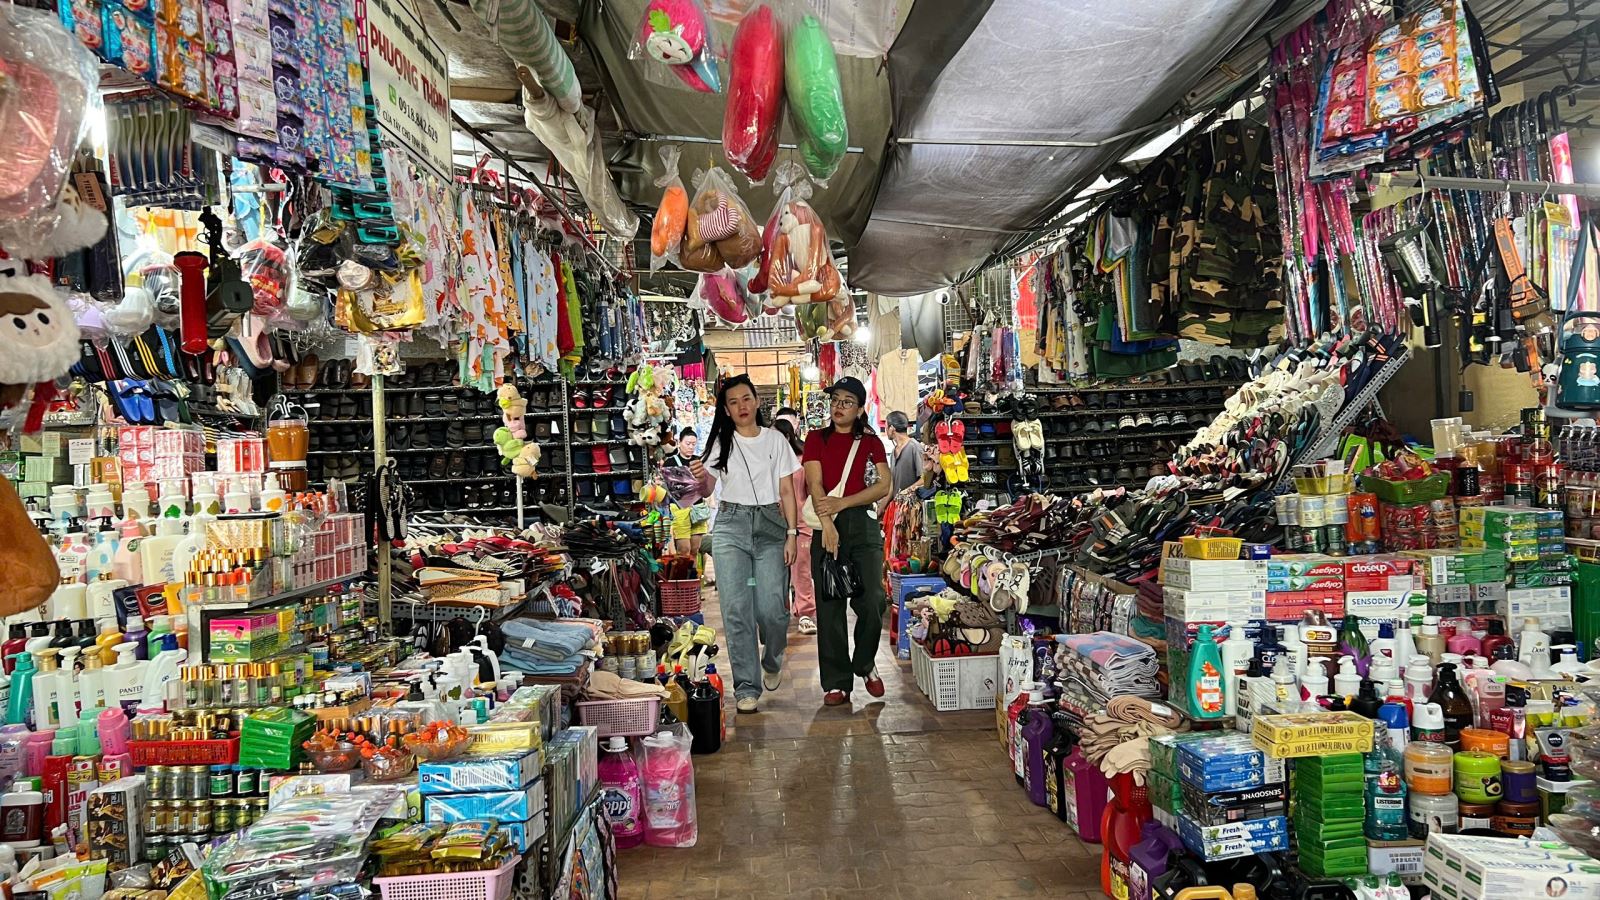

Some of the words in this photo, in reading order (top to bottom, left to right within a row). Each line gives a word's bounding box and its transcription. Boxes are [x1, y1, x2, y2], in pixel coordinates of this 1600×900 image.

[1310, 567, 1343, 576] Colgate
[1352, 563, 1387, 574] closeup
[1311, 582, 1343, 590] Colgate
[1352, 597, 1398, 605] SENSODYNE
[1358, 617, 1398, 625] ENSODYNE
[1335, 726, 1354, 735] BRAND
[1333, 741, 1353, 750] BRAND
[1241, 788, 1282, 800] SENSODYNE
[605, 797, 631, 815] oppi
